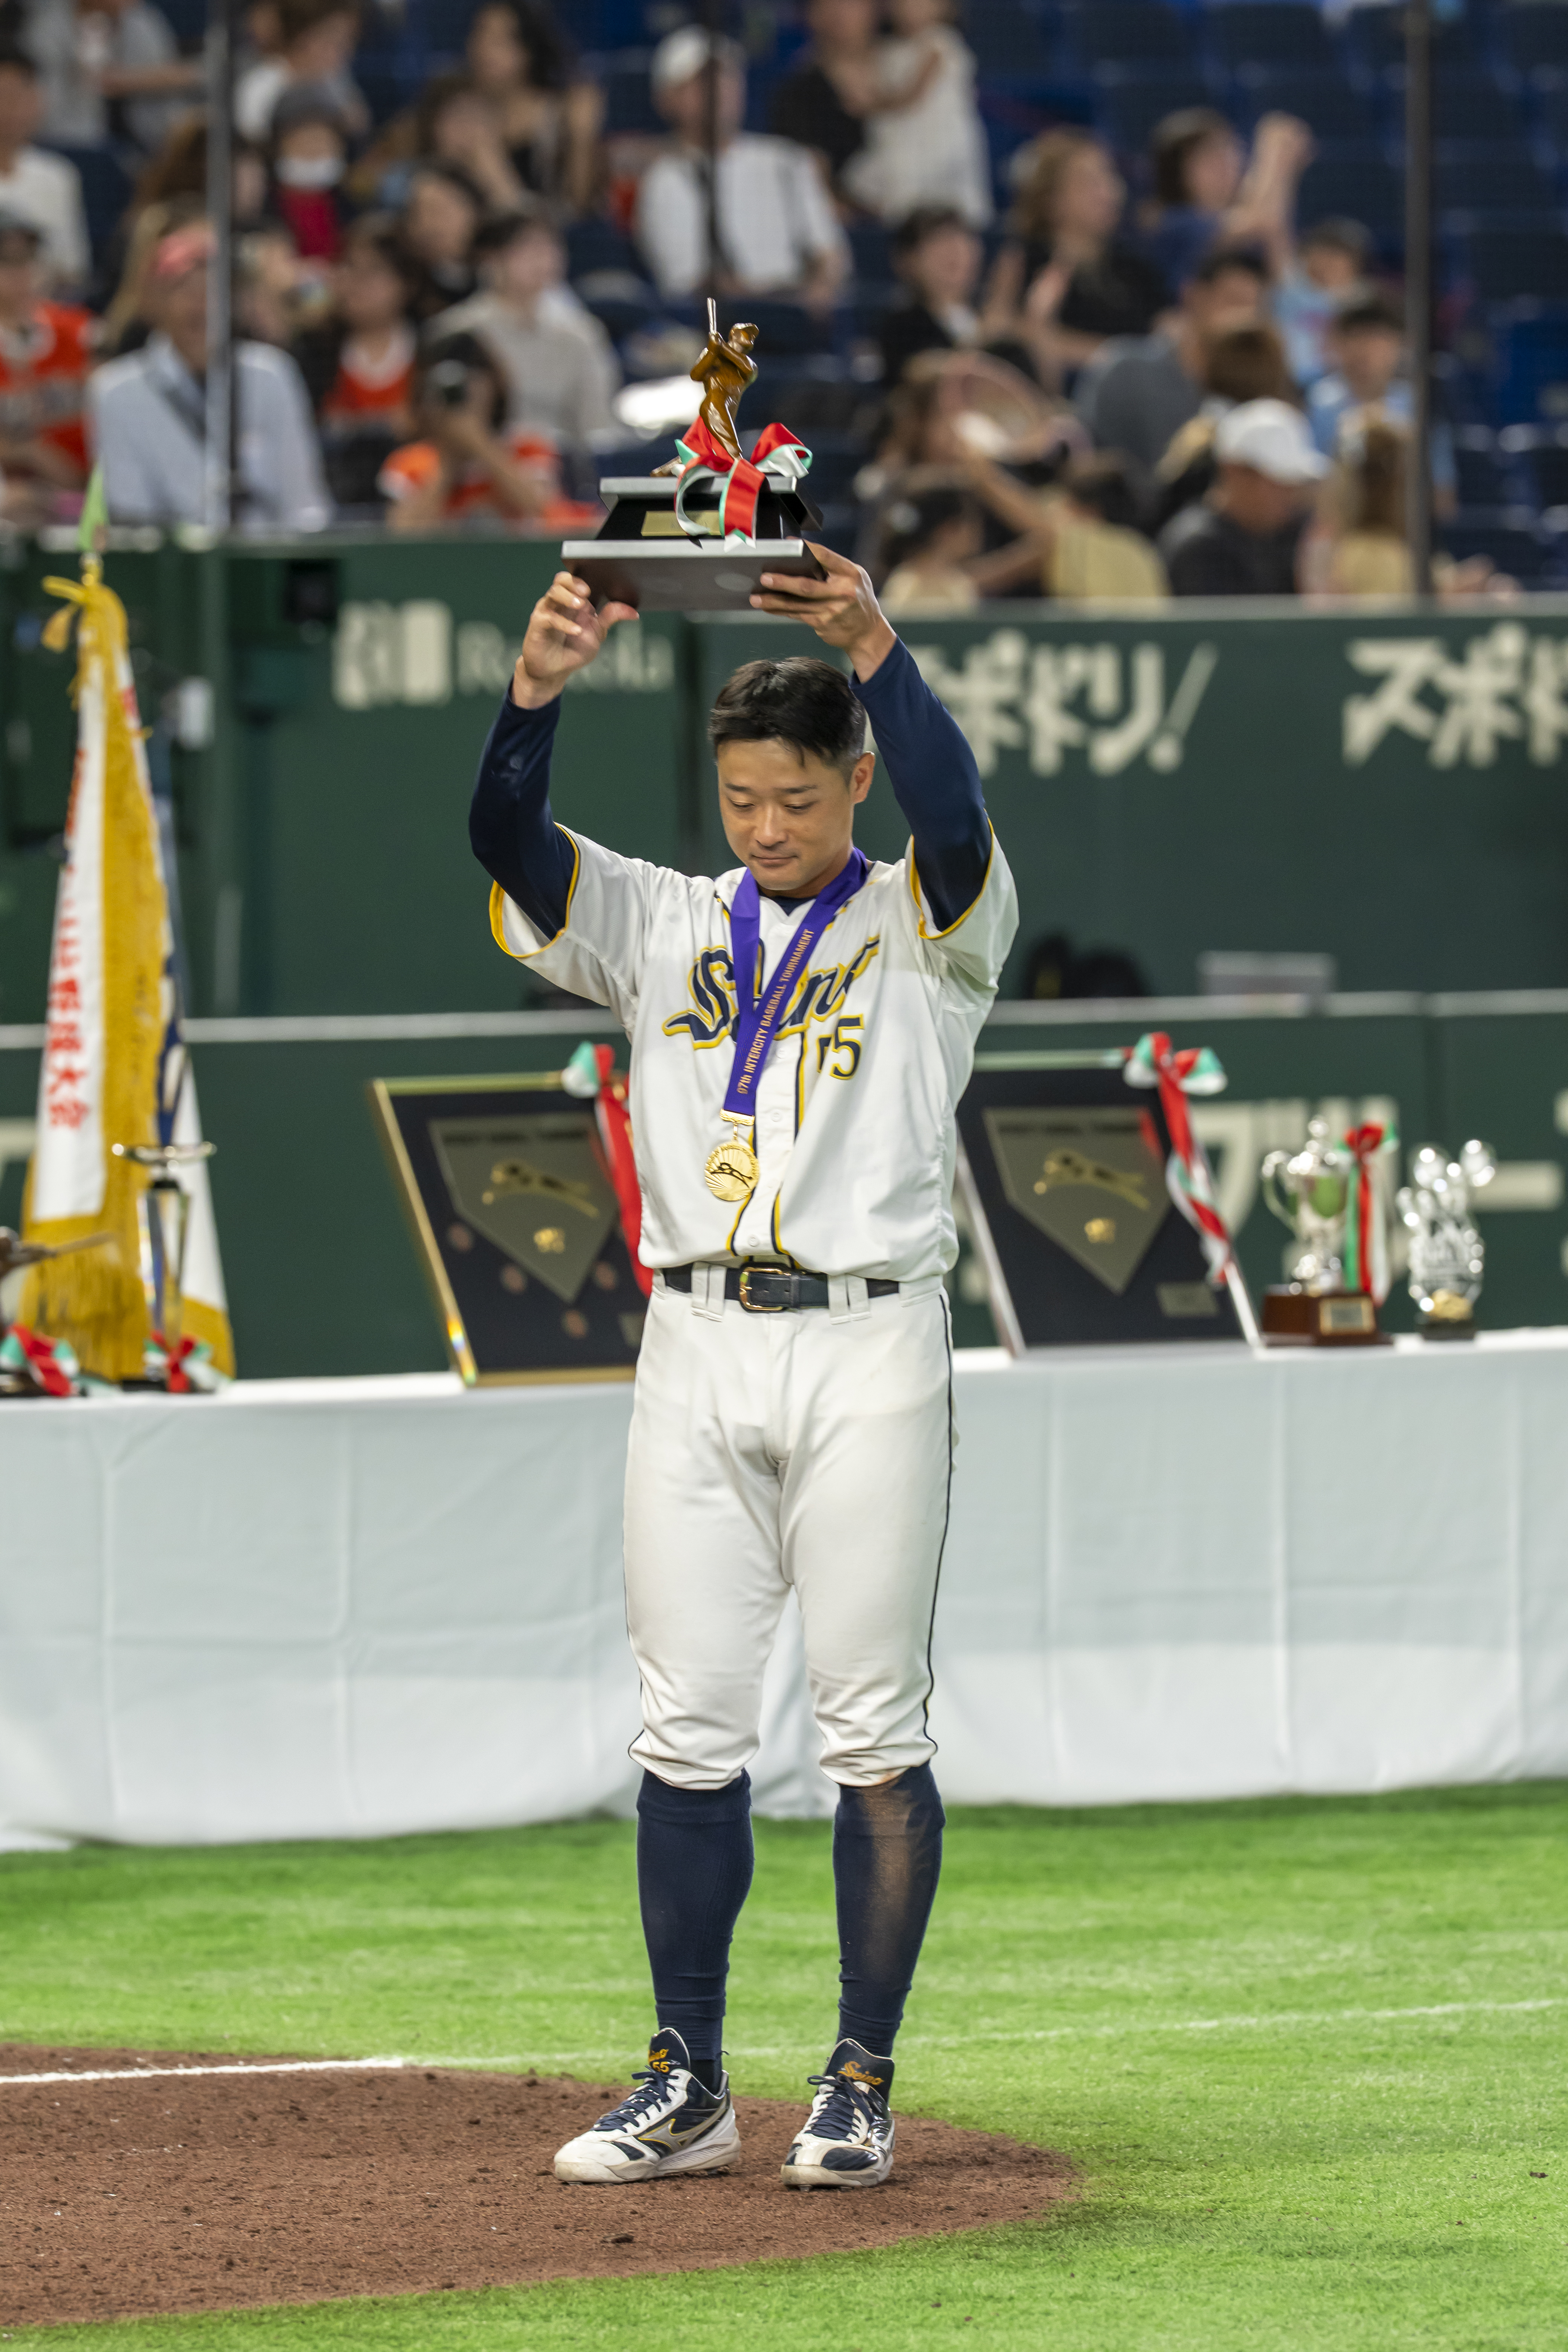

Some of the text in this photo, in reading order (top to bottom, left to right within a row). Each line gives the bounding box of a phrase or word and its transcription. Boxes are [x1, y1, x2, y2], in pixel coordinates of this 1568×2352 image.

[743, 1027, 769, 1073] INTERCITY
[760, 984, 787, 1027] BASEBALL
[779, 928, 815, 982] TOURNAMENT
[652, 2061, 669, 2073] 55
[837, 2061, 885, 2086] Seino
